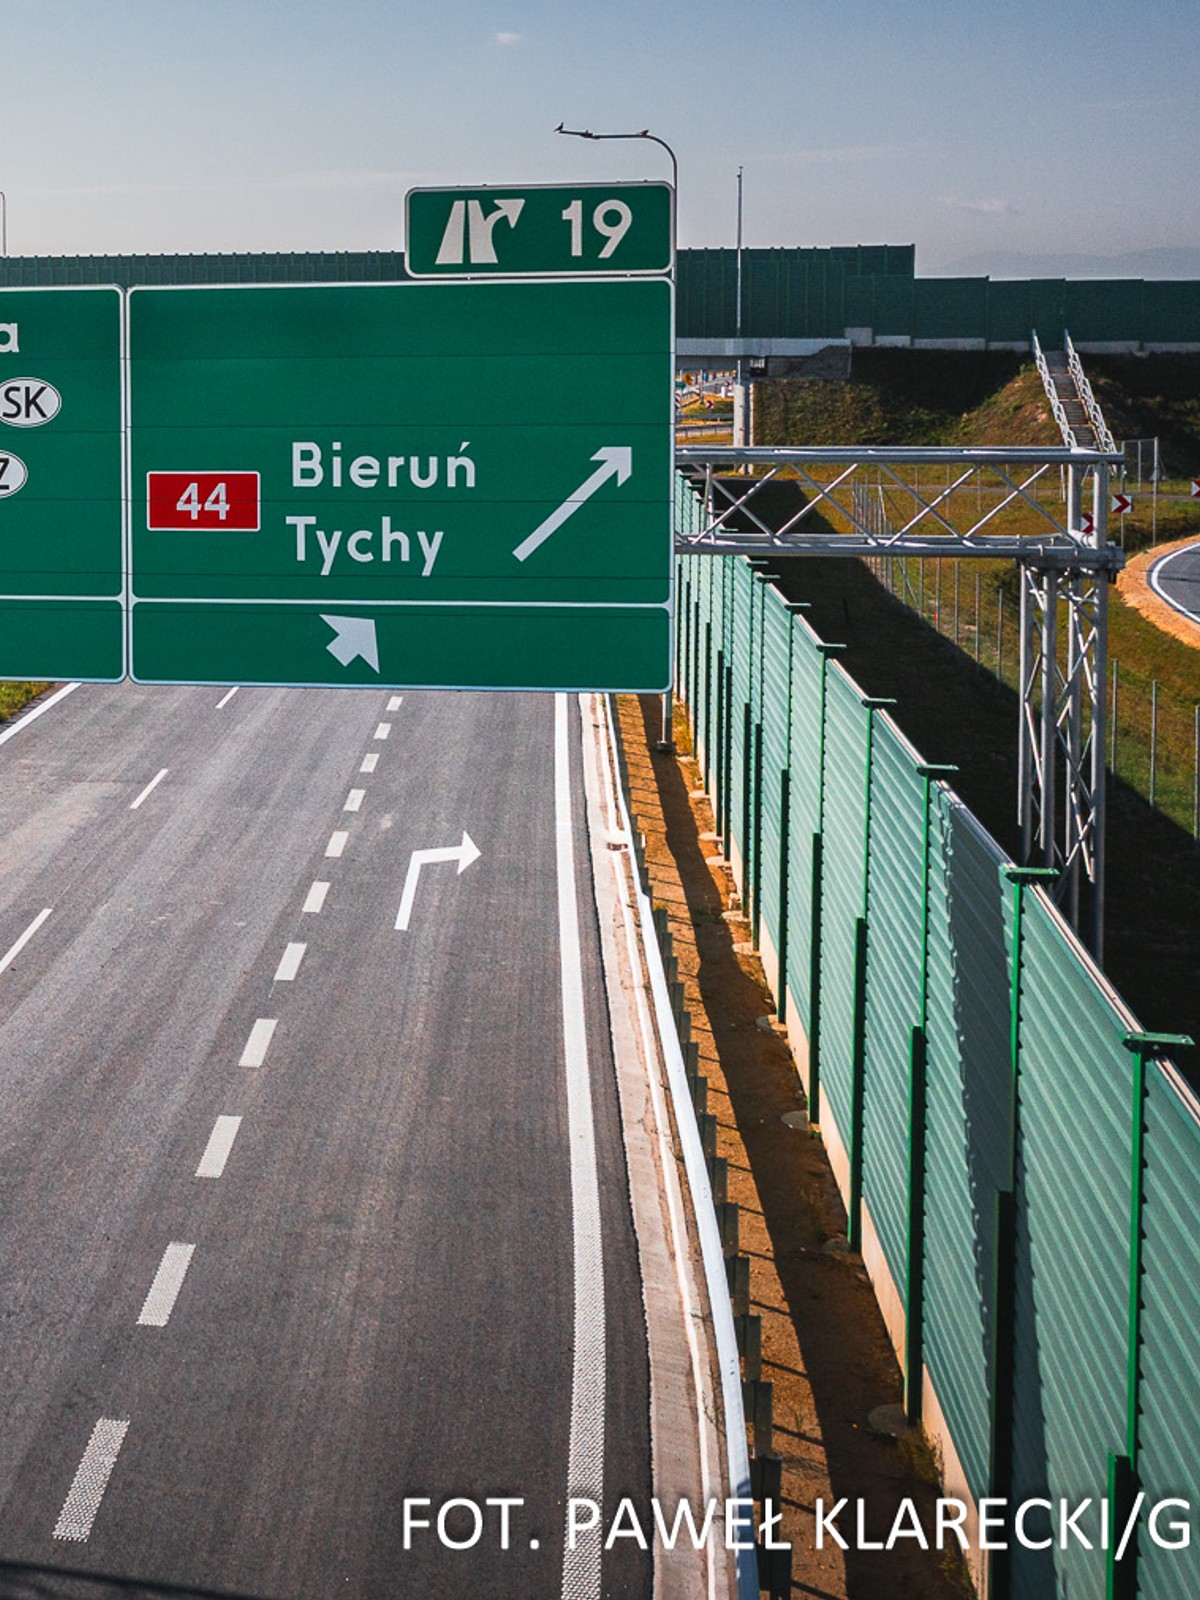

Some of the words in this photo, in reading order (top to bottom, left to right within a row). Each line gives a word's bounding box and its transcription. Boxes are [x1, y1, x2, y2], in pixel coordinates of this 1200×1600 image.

[562, 199, 632, 259] 19
[2, 386, 52, 420] SK
[292, 441, 475, 489] Bieruń
[176, 482, 230, 520] 44
[285, 516, 444, 577] Tychy
